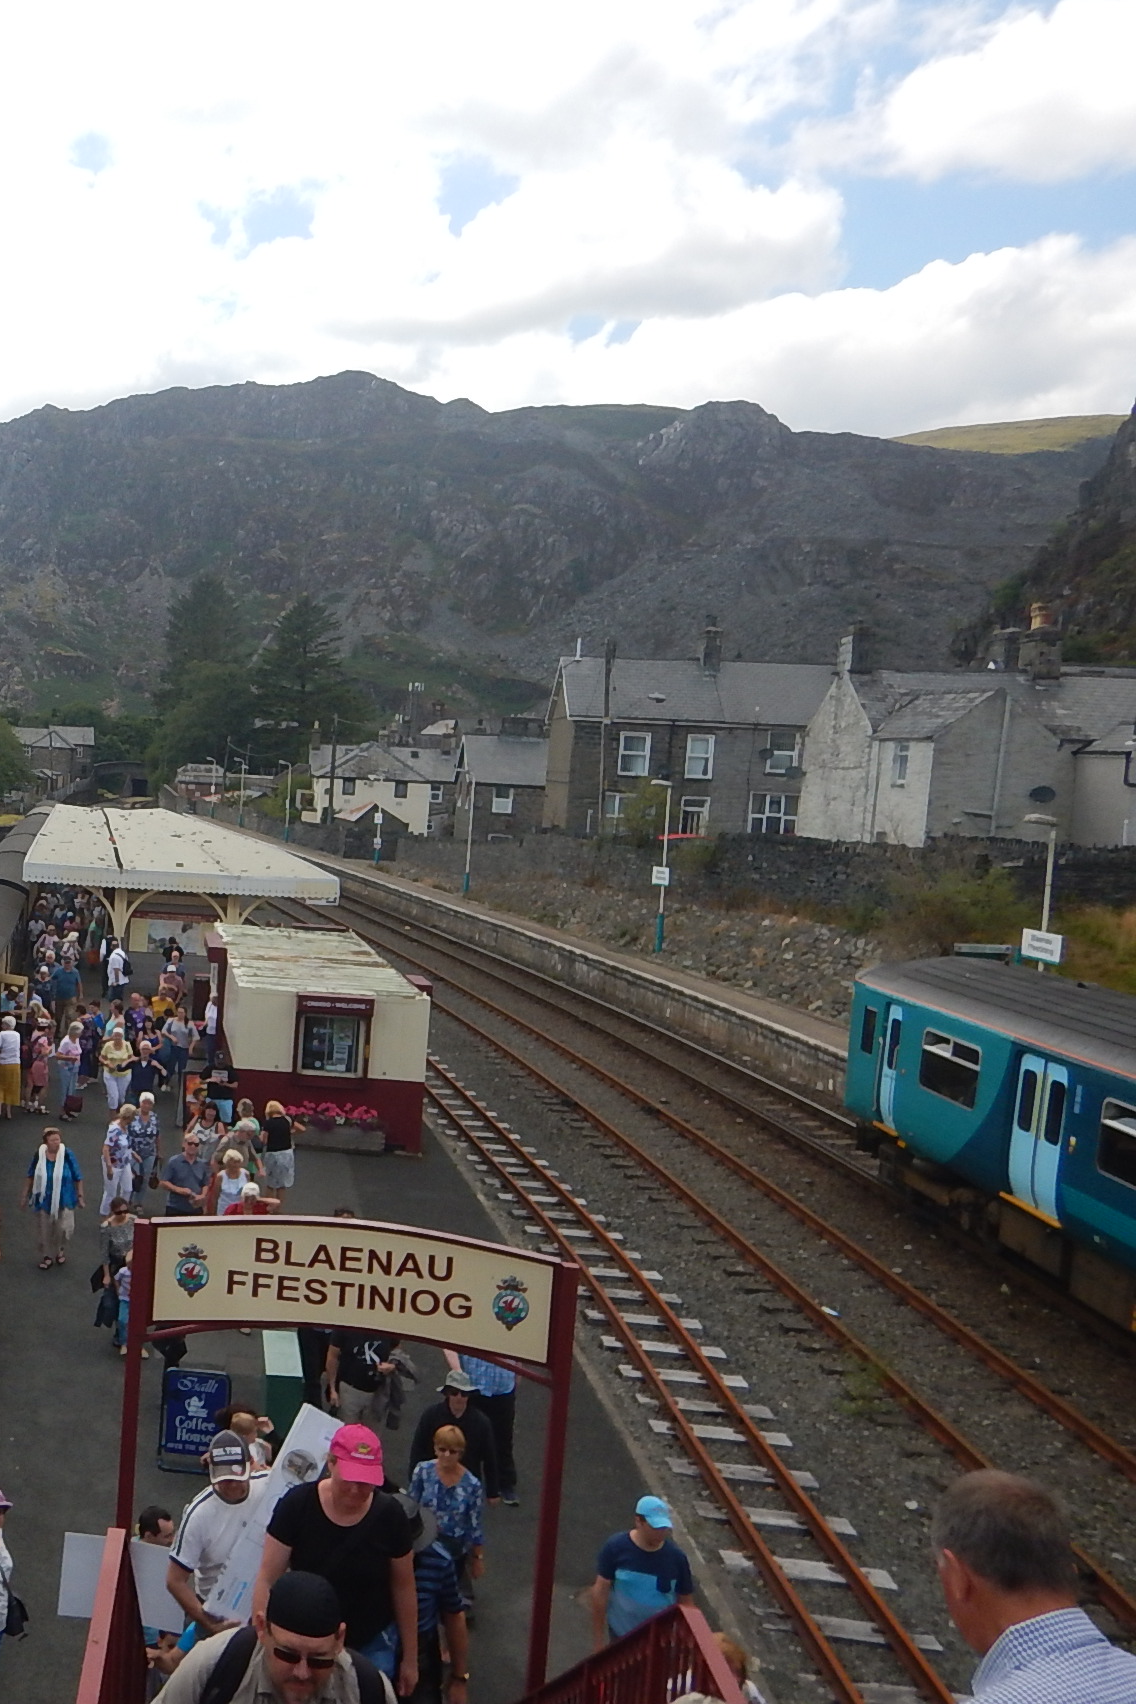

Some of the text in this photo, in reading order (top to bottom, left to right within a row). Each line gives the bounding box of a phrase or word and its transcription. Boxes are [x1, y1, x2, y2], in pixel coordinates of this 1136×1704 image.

[254, 1237, 454, 1282] BLAENAU
[226, 1269, 473, 1319] FFESTINIOG
[175, 1415, 216, 1432] Coffee
